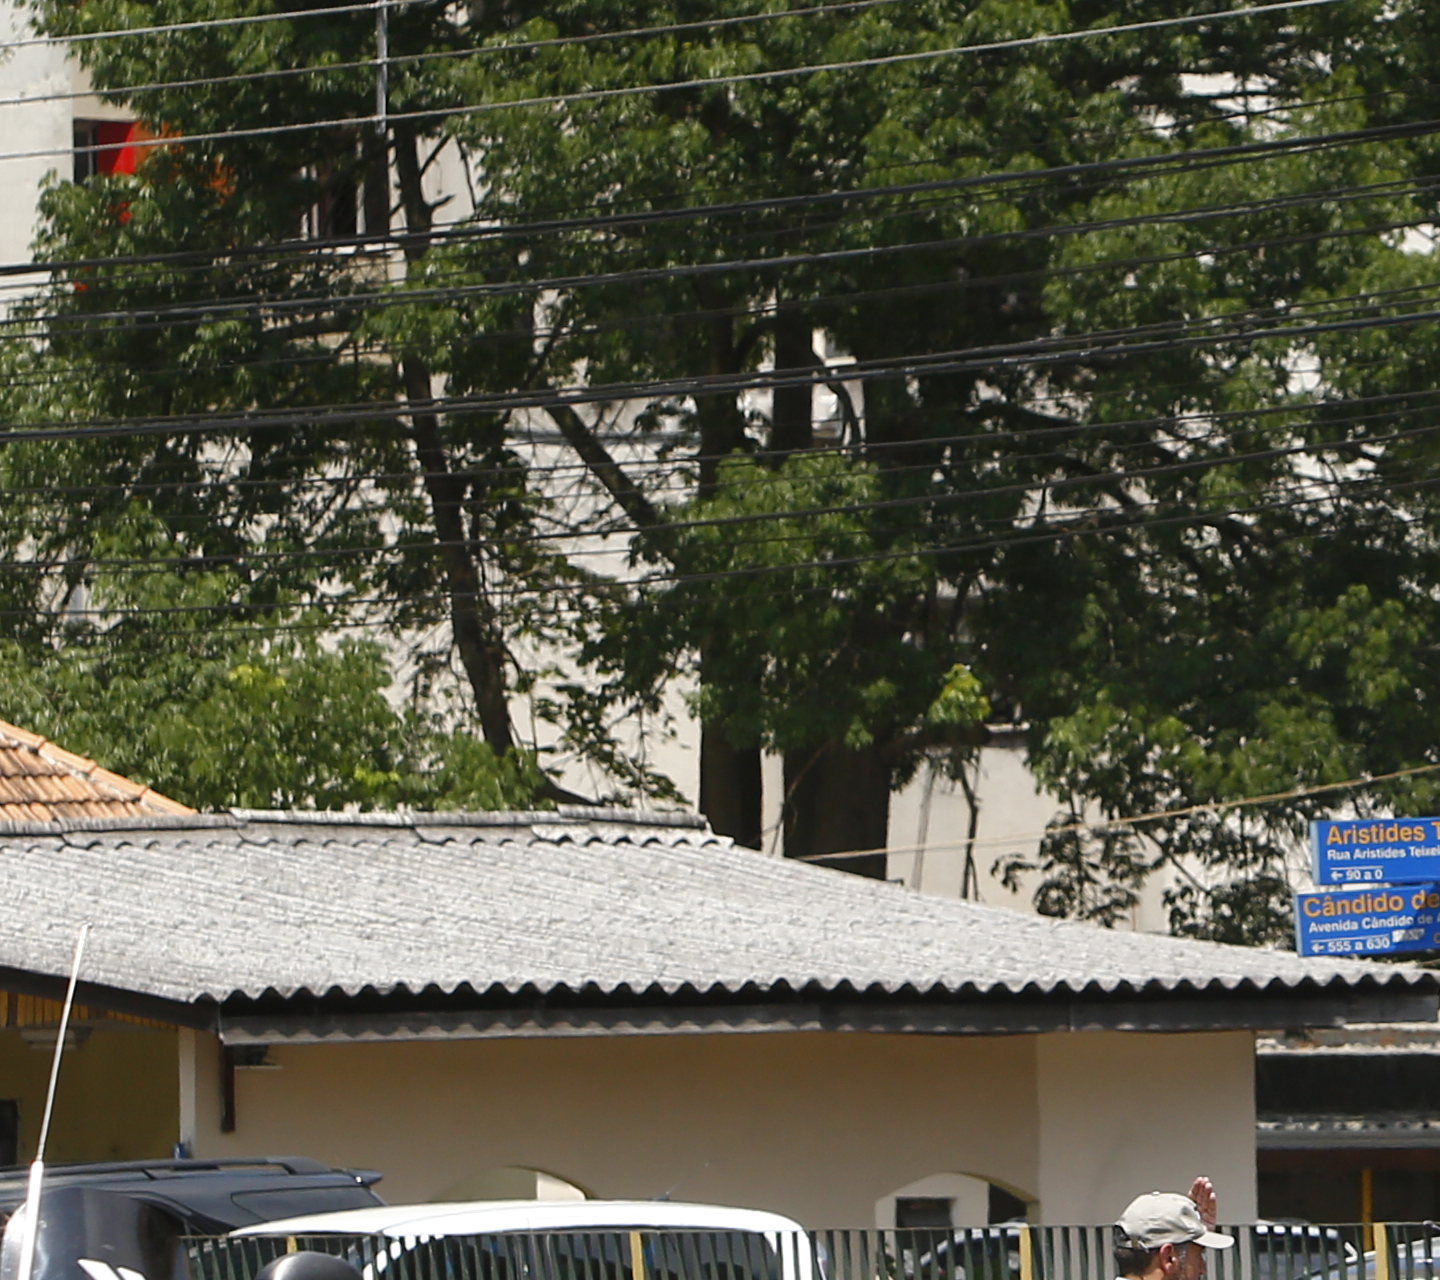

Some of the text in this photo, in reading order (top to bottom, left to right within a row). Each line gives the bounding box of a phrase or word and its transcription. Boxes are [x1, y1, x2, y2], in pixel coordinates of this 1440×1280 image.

[1327, 823, 1425, 845] Aristides
[1327, 849, 1350, 860] Rua
[1353, 847, 1406, 860] Aristides
[1346, 869, 1383, 880] 90 a 0
[1303, 891, 1404, 918] Cândido
[1411, 889, 1440, 910] de
[1309, 920, 1359, 933] Avenida
[1361, 915, 1414, 930] Cândido
[1418, 914, 1433, 924] de
[1327, 937, 1391, 952] 555 a 630
